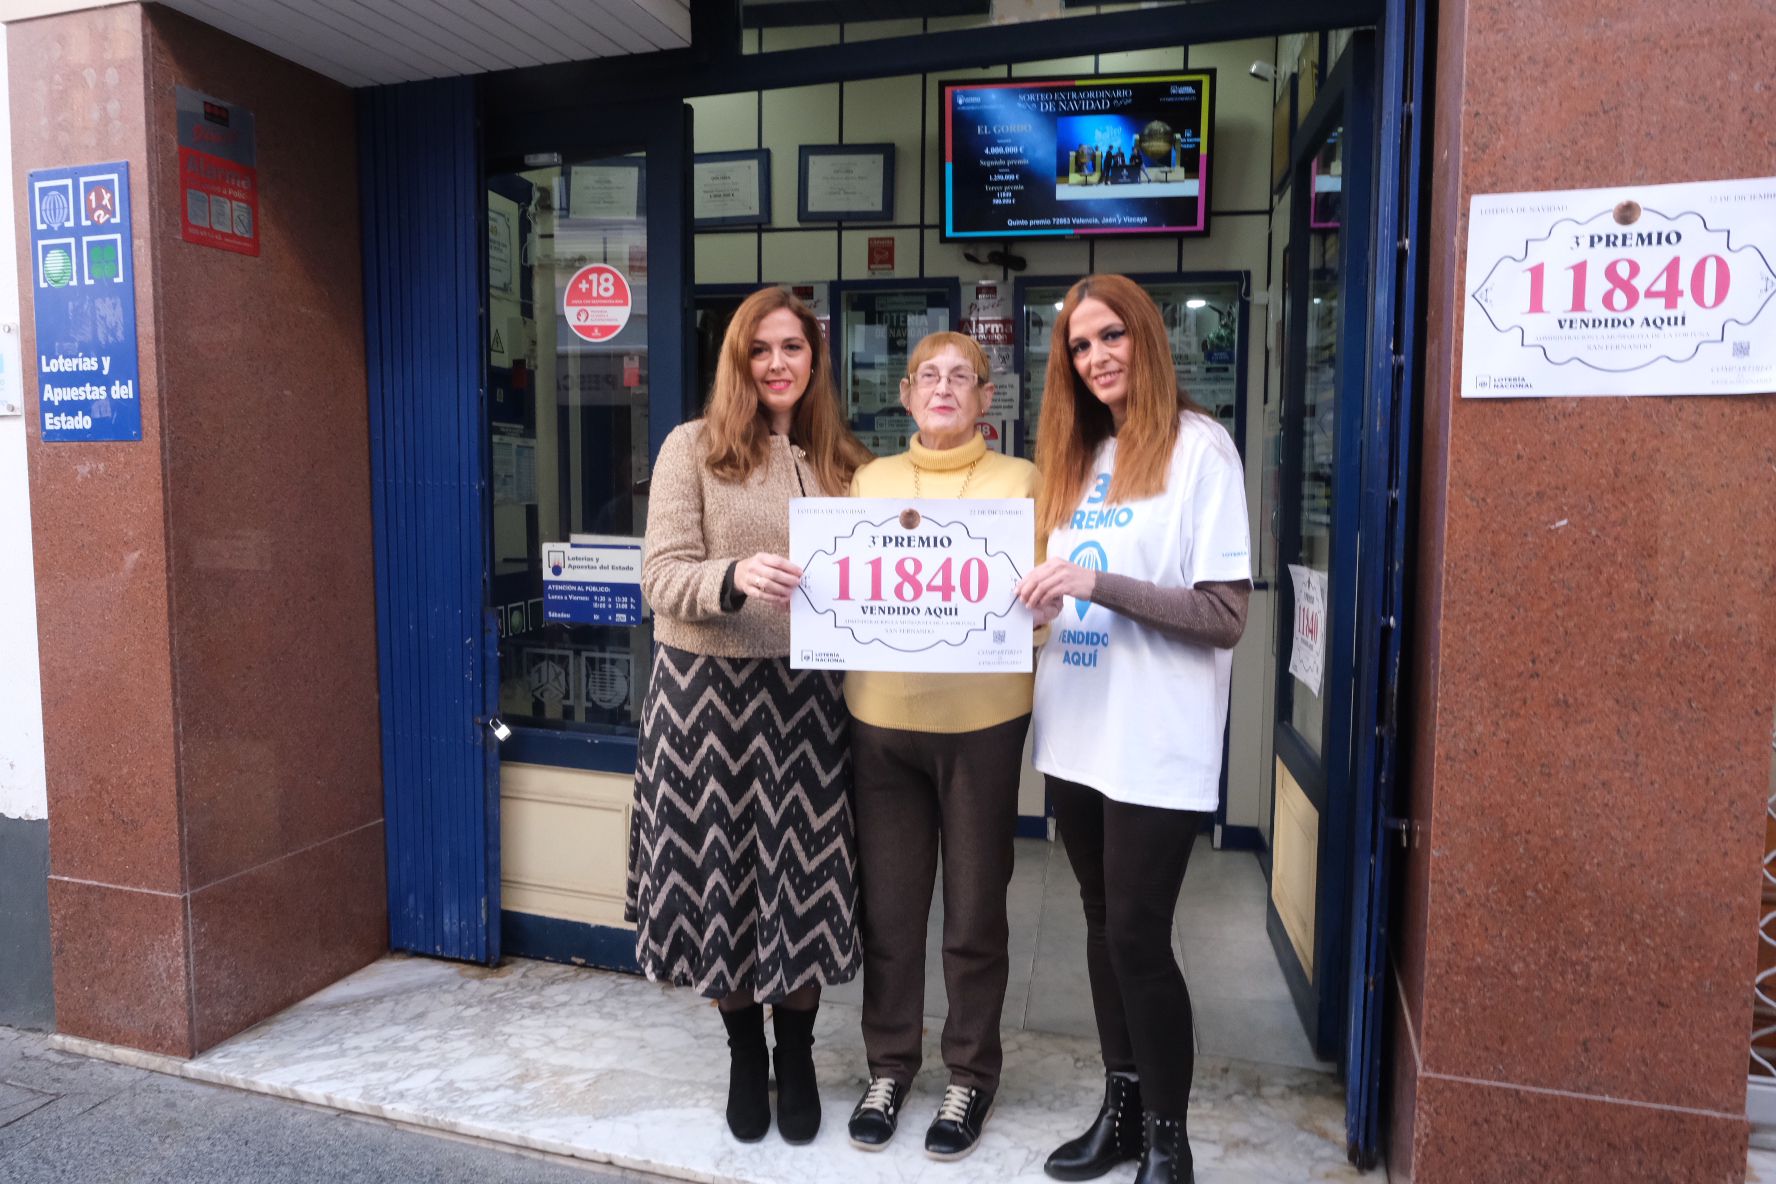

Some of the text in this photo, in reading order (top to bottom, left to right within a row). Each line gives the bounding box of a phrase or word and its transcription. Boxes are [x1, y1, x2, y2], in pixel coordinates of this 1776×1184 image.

[1054, 89, 1132, 101] EXTRAORDINARIO
[1040, 100, 1111, 112] DE NAVIDAD
[977, 123, 1032, 135] EL GORDO
[1007, 218, 1028, 227] Quinto
[1029, 218, 1051, 228] premio
[1588, 230, 1682, 248] PREMIO
[579, 273, 615, 298] +18
[1520, 254, 1731, 315] 11840
[1556, 312, 1686, 331] VENDIDO AQUÍ
[42, 355, 111, 375] Loterías y
[44, 379, 134, 406] Apuestas del
[45, 410, 92, 430] Estado
[1070, 507, 1134, 530] REMIO
[882, 534, 952, 548] PREMIO
[832, 556, 990, 603] 11840
[860, 603, 958, 620] VENDIDO AQUÍ
[1062, 650, 1098, 668] AQUÍ
